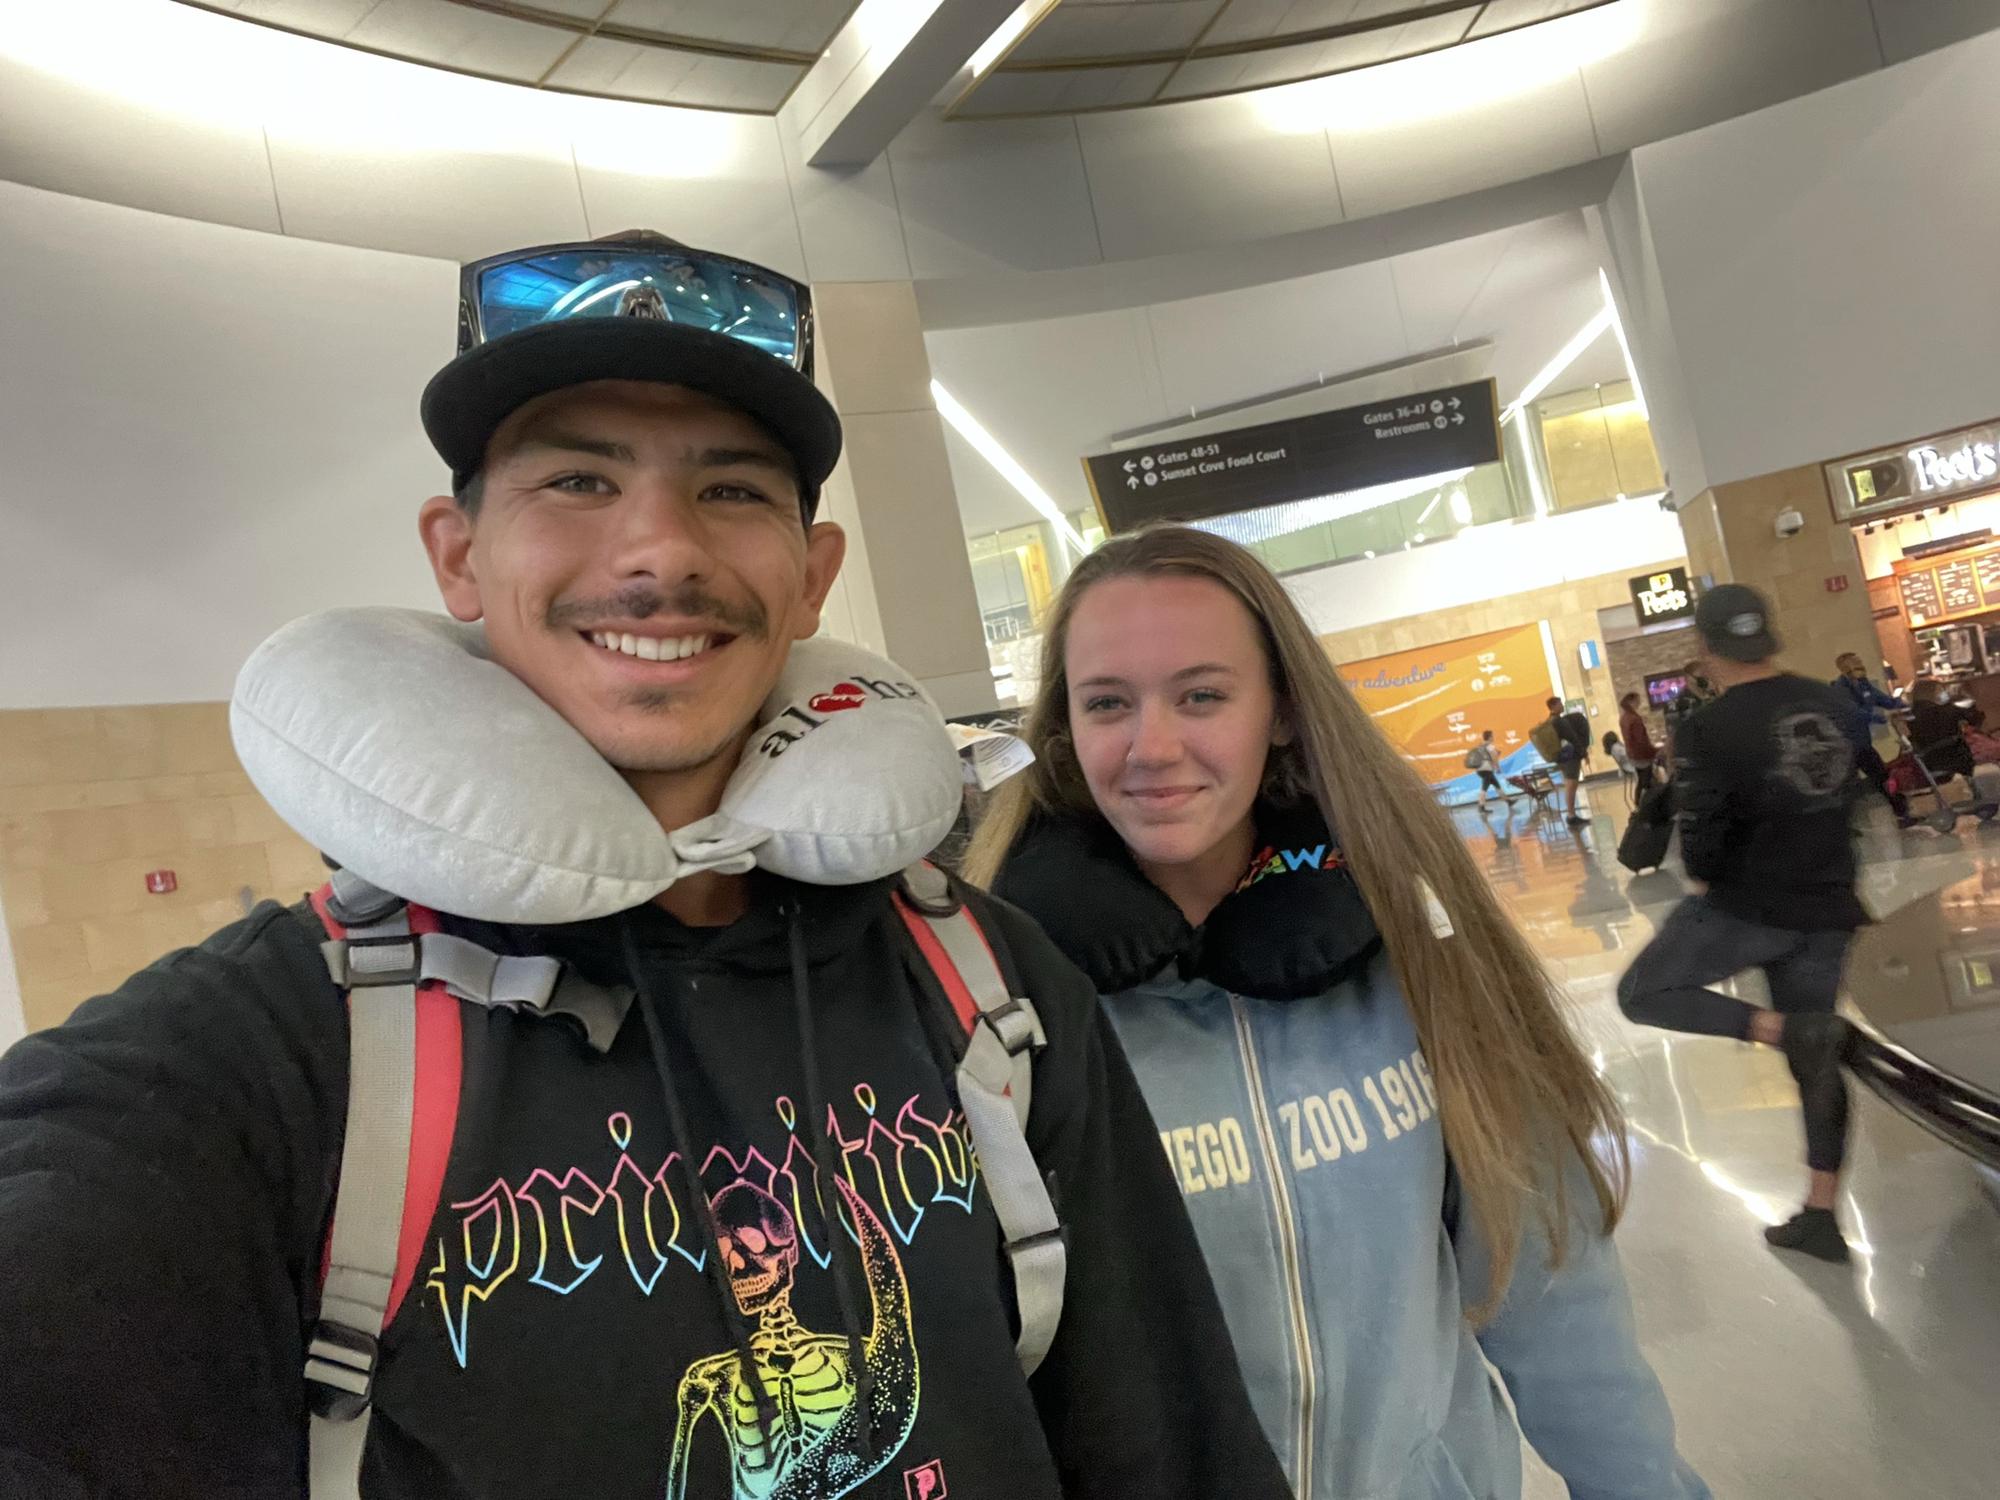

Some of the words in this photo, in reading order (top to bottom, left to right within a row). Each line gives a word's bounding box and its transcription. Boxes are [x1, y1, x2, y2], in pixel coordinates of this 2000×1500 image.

[1363, 412, 1394, 425] Gates
[1374, 421, 1431, 438] Restrooms
[1157, 451, 1189, 465] Gates
[1190, 444, 1220, 458] 48-51
[1160, 466, 1197, 481] Sunset
[1199, 462, 1225, 473] Cove
[1227, 454, 1253, 468] Food
[1256, 448, 1286, 462] Court
[1363, 664, 1446, 689] adventure
[1278, 1087, 1368, 1172] ZOO
